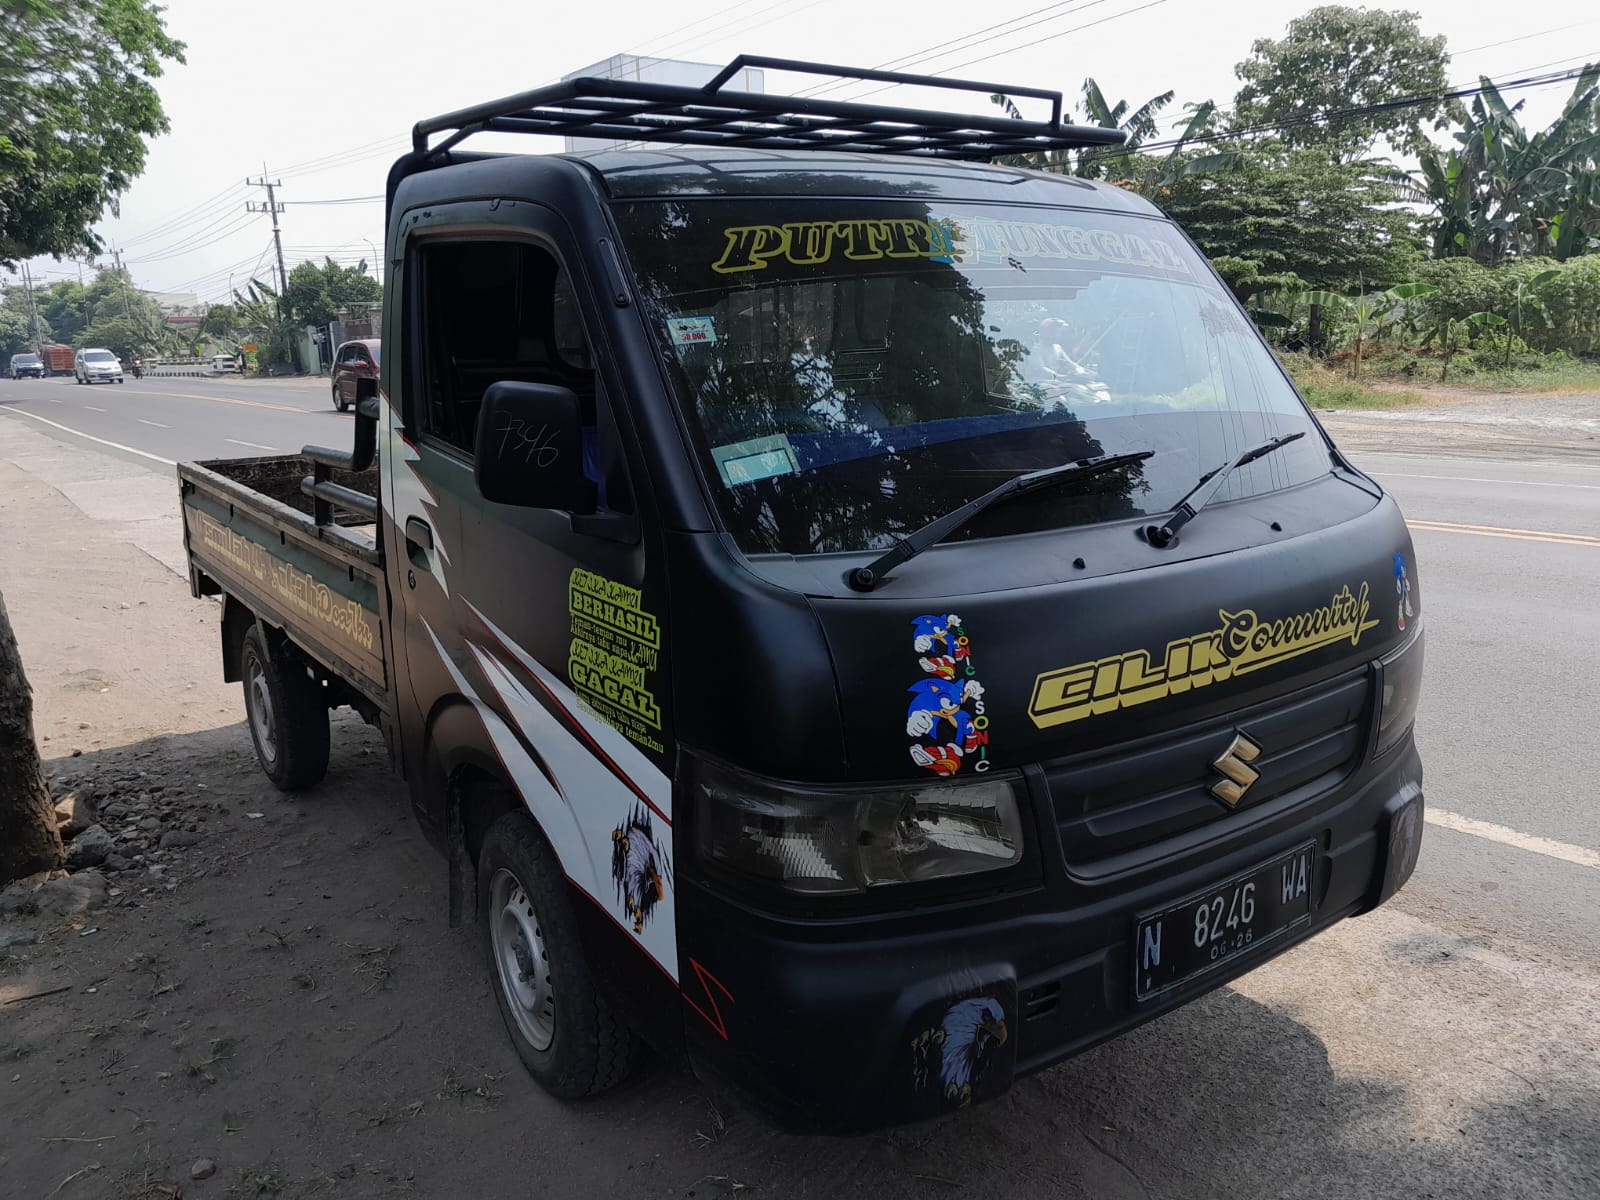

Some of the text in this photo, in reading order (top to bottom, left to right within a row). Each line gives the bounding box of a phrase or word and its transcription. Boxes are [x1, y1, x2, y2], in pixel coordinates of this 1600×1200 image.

[965, 220, 1190, 274] TUNGGAL
[573, 590, 655, 641] BERHASIL
[956, 627, 976, 677] SONIC
[1028, 630, 1234, 729] CILIK
[572, 662, 655, 719] GAGAL
[974, 701, 990, 773] SONIC
[1143, 855, 1307, 970] N 8246 WA
